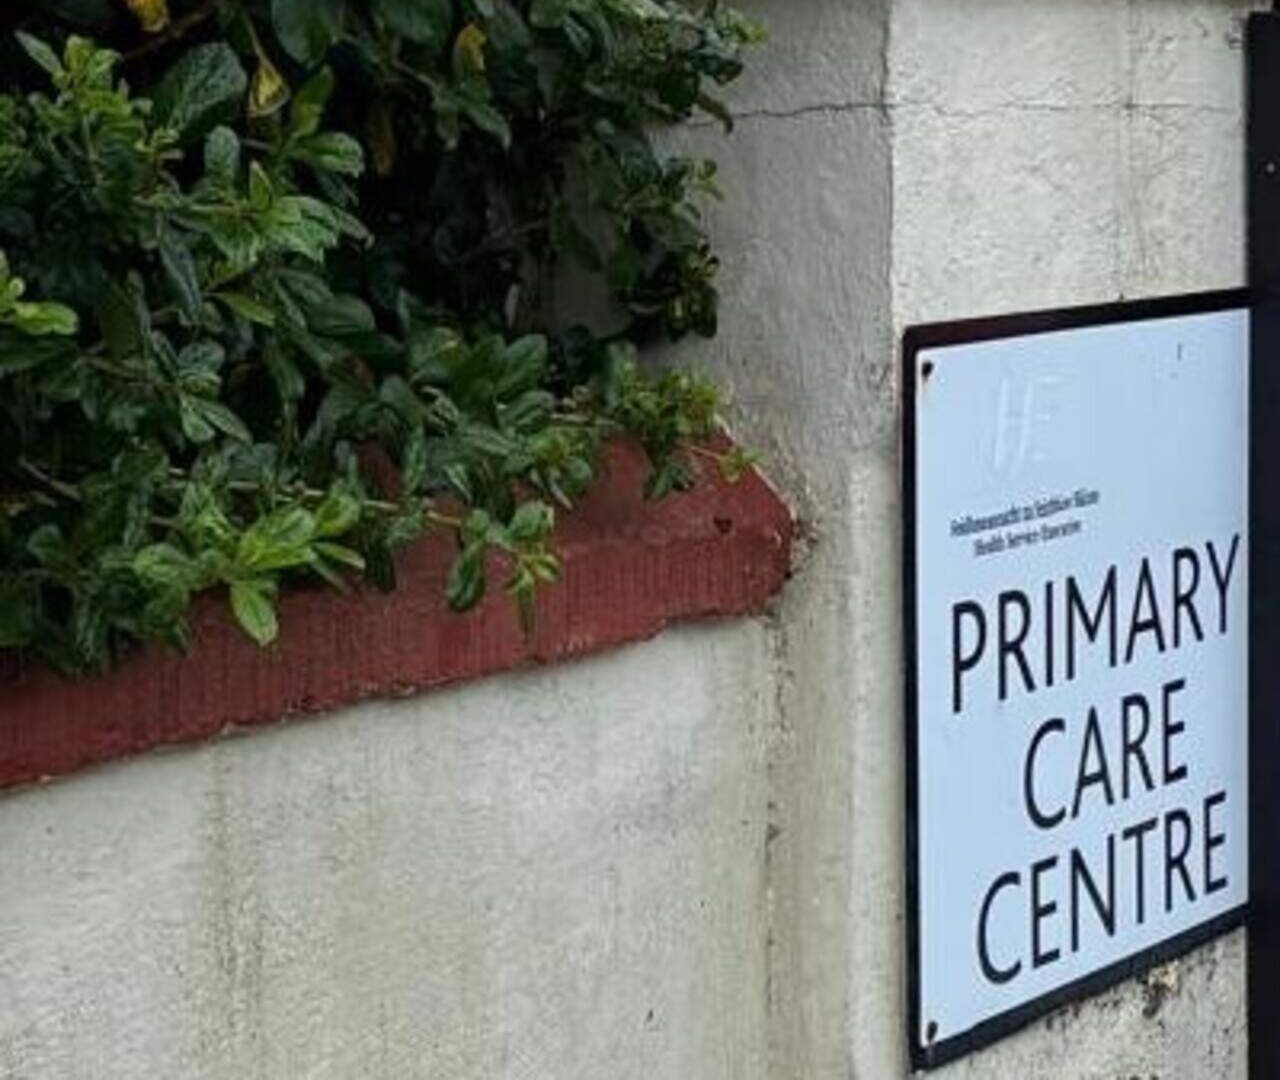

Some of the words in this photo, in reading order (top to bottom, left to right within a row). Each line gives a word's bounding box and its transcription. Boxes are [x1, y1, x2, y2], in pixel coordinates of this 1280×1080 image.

[952, 533, 1240, 714] PRIMARY
[1024, 677, 1189, 831] CARE
[976, 790, 1229, 985] CENTRE
